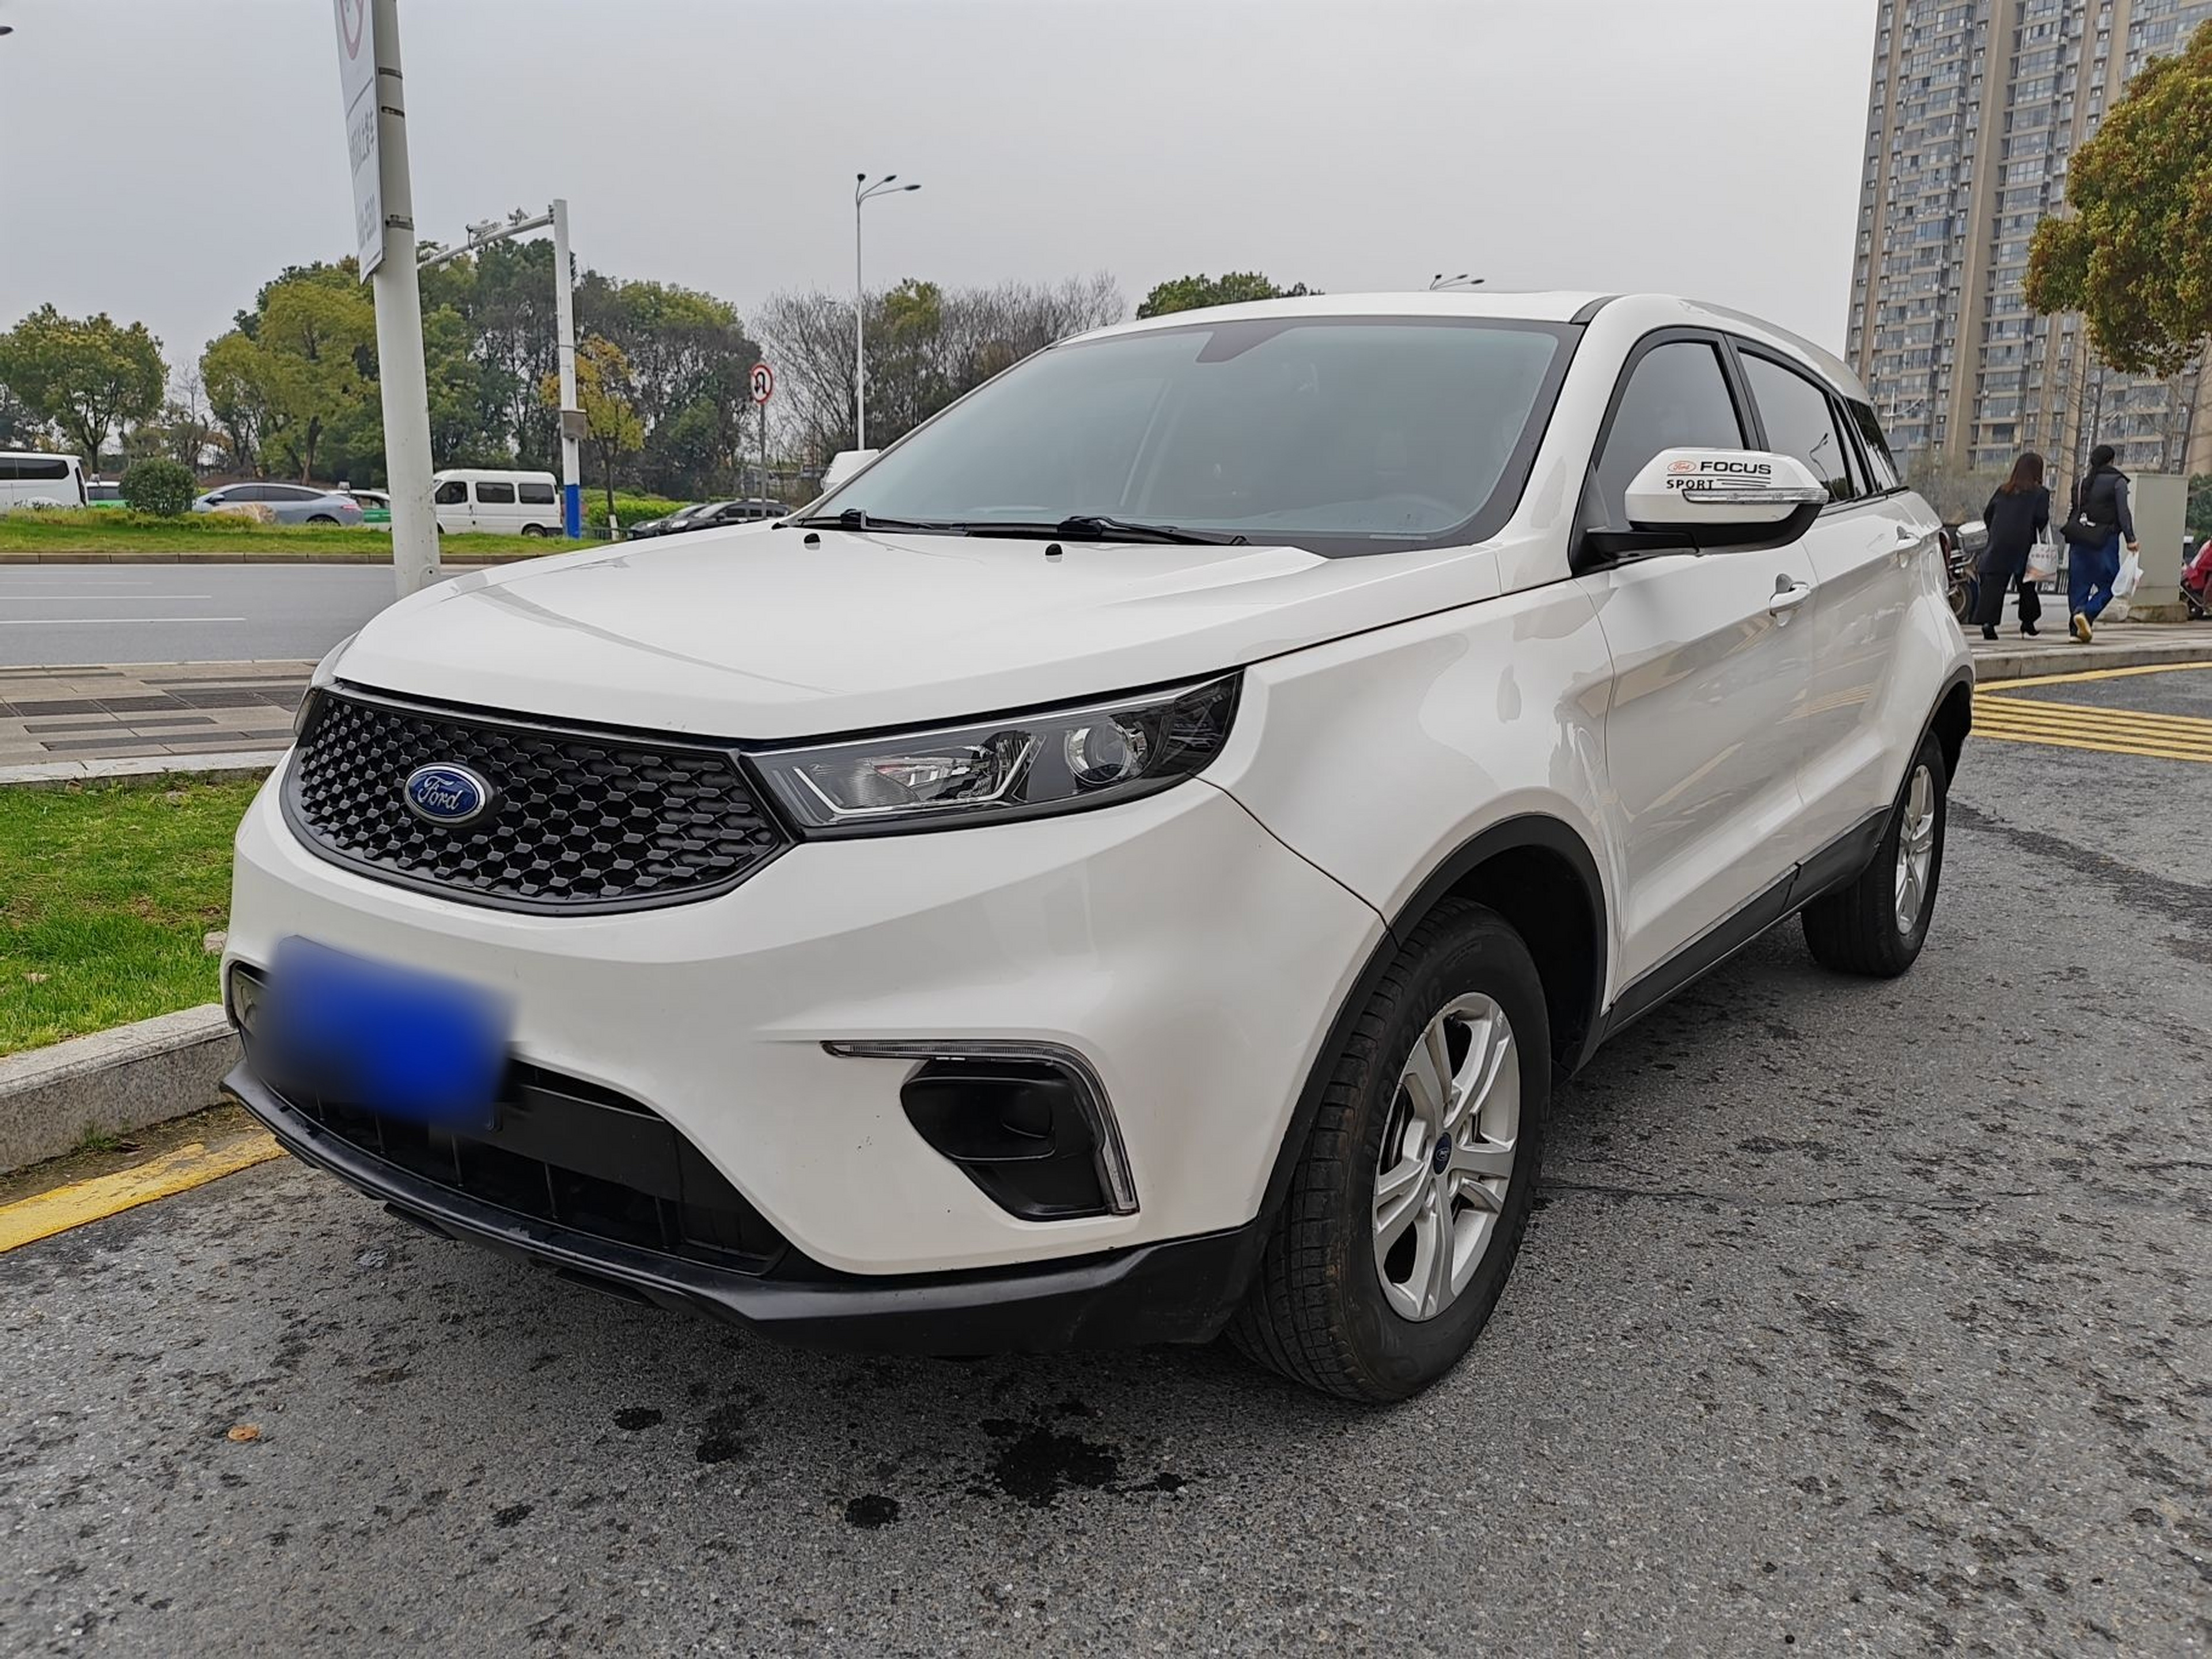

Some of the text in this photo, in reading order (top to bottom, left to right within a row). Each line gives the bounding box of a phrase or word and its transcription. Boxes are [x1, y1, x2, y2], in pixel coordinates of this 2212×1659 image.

[1700, 461, 1771, 475] FOCUS
[1666, 479, 1714, 490] SPORT
[418, 775, 463, 810] Ford
